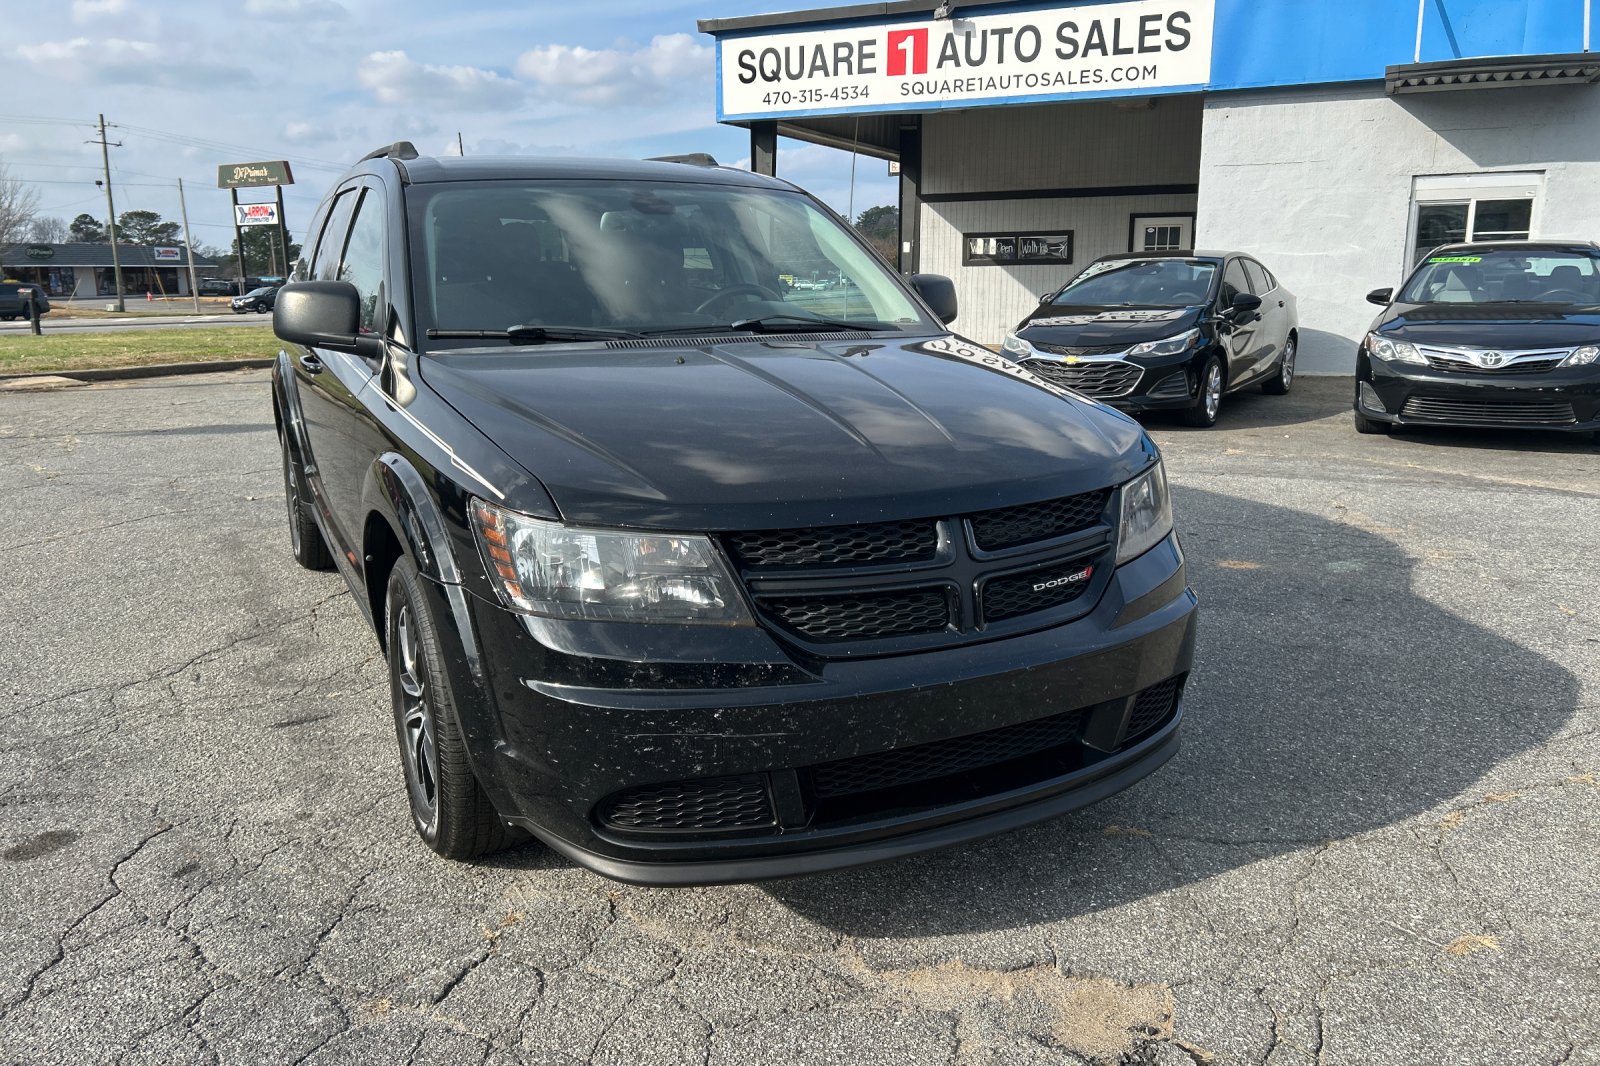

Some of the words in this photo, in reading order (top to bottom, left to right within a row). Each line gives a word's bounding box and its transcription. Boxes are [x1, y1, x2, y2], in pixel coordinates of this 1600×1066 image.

[738, 39, 877, 84] SQUARE
[897, 35, 915, 75] 1
[936, 24, 1042, 69] AUTO
[1055, 11, 1191, 60] SALES
[900, 65, 1158, 96] SQUARE1AUTOSALES.COM
[762, 85, 870, 105] 470-315-4534
[247, 206, 270, 217] ARROW
[1033, 570, 1087, 591] DODGE
